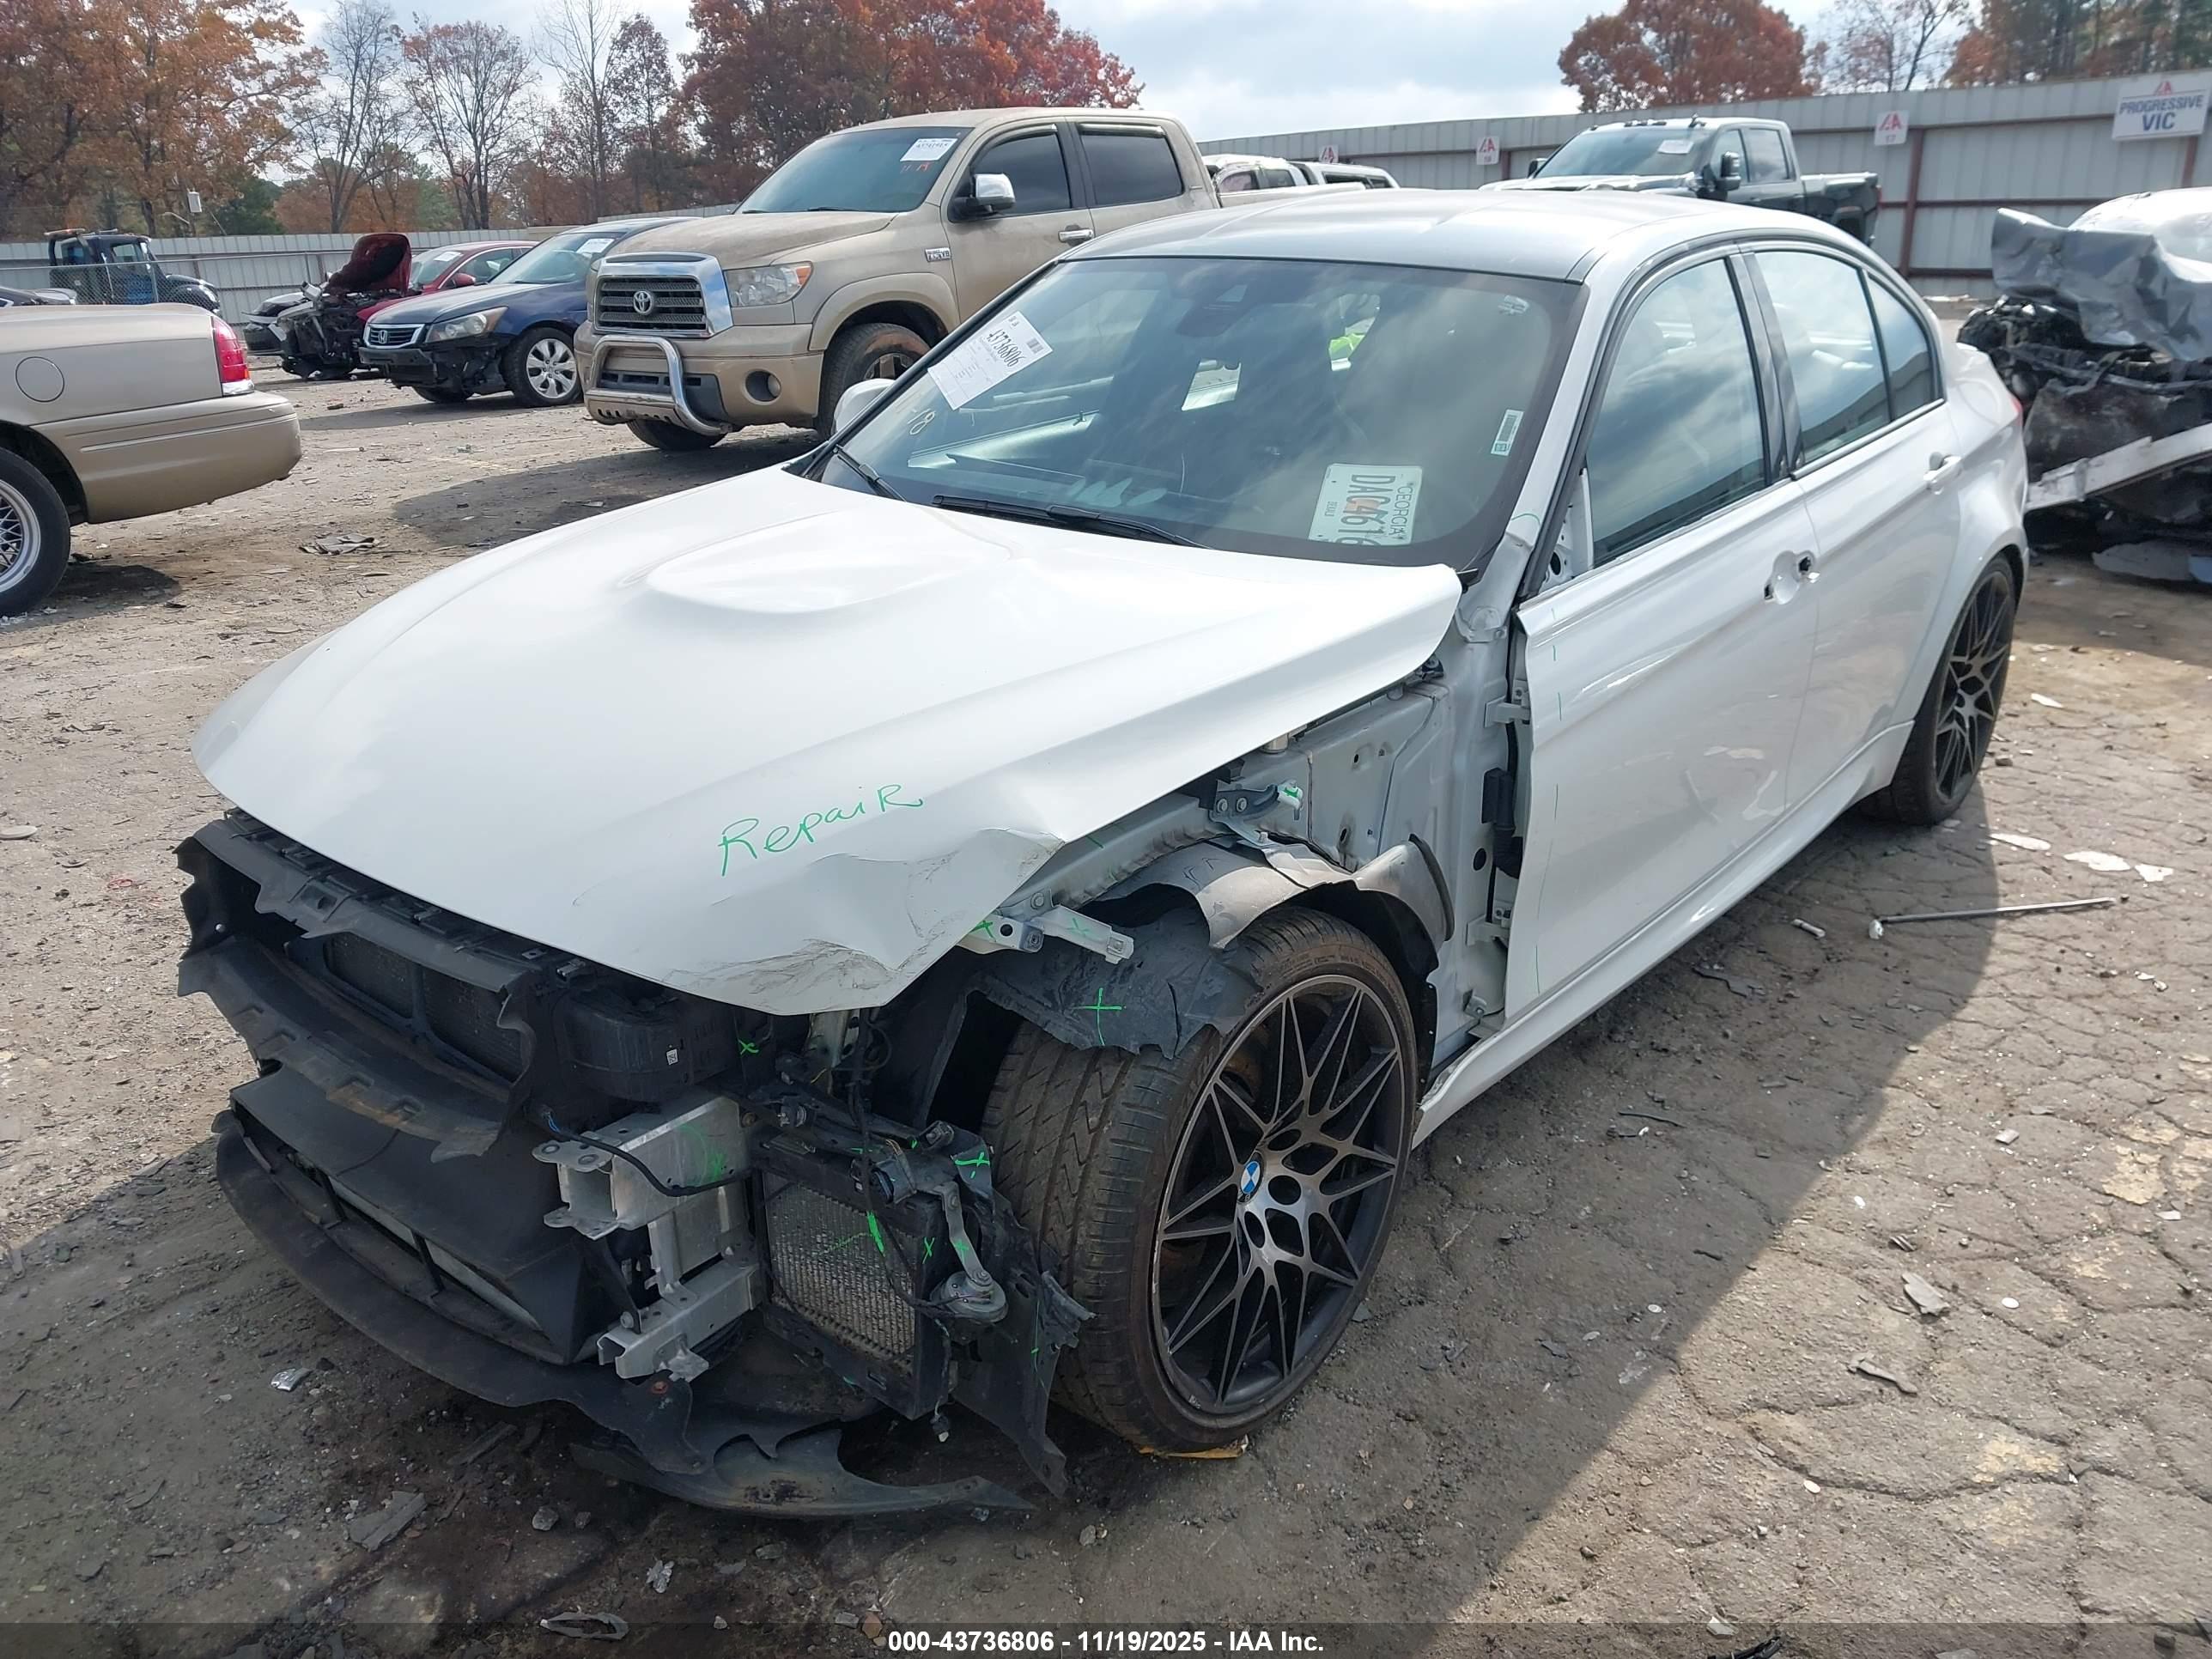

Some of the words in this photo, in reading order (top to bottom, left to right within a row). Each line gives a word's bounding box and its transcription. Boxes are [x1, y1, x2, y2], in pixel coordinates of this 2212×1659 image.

[2119, 94, 2205, 115] PROGRESSIVE
[2142, 112, 2177, 131] VIC
[987, 329, 1027, 368] 43736806
[1389, 487, 1413, 536] GEORGIA
